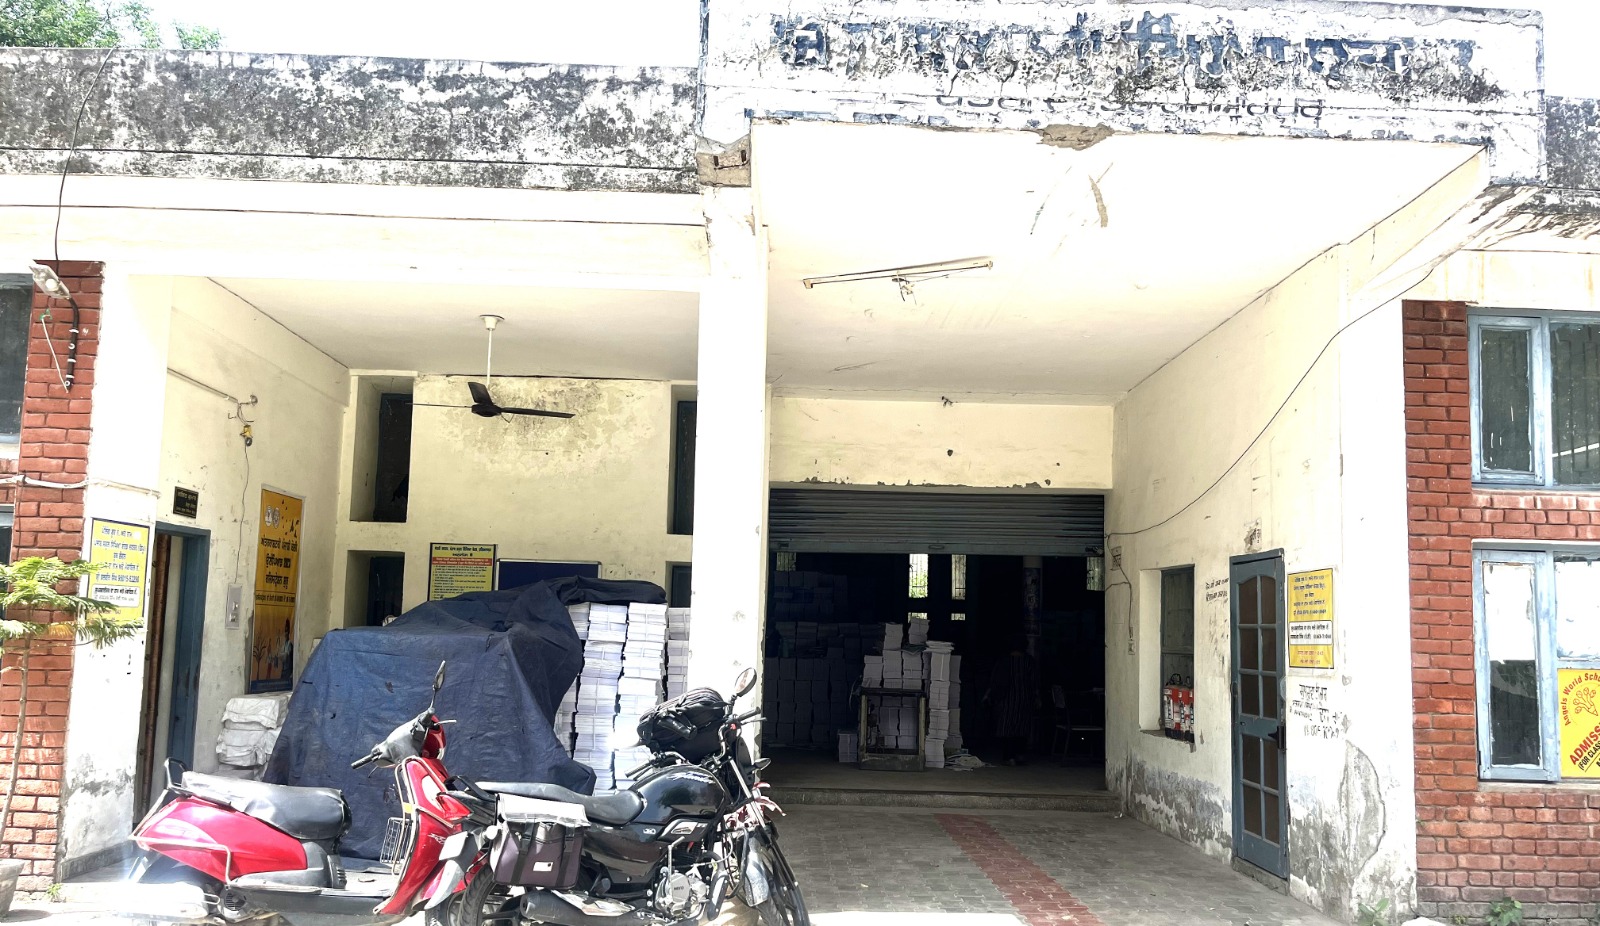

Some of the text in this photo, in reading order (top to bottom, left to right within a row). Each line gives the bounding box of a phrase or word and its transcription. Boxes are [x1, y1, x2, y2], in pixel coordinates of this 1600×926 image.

[1563, 676, 1583, 695] World
[1561, 698, 1571, 726] Angels
[1578, 756, 1591, 771] (FOR
